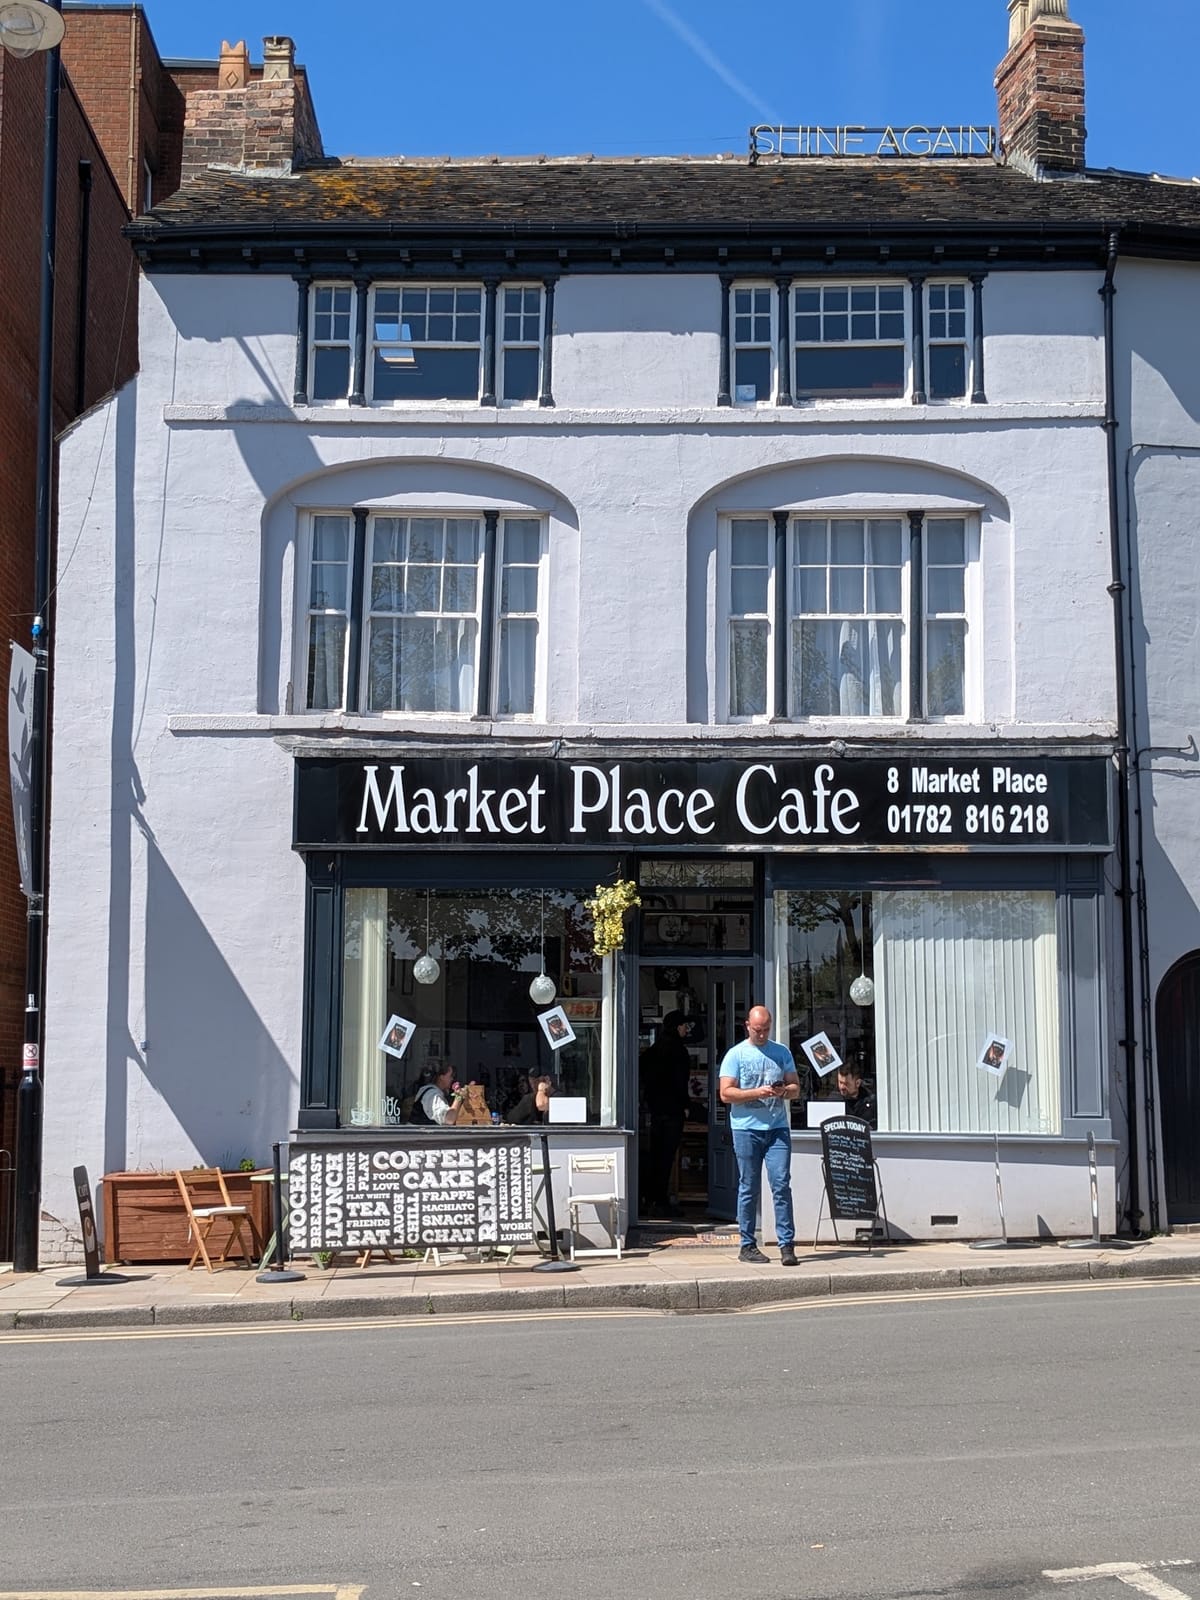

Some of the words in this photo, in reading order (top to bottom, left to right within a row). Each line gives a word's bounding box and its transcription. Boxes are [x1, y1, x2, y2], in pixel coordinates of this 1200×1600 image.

[754, 124, 865, 156] SHINE
[877, 124, 992, 156] AGAIN
[887, 767, 899, 793] 8
[912, 767, 980, 793] Market
[993, 767, 1048, 793] Place
[356, 765, 546, 834] Market
[570, 764, 715, 834] Place
[736, 764, 860, 834] Cafe
[887, 805, 952, 833] 01782
[824, 1121, 846, 1133] SPECIAL
[846, 1121, 866, 1133] TODAY
[346, 1152, 356, 1191] DRINK
[358, 1152, 370, 1191] PLAY
[373, 1149, 475, 1170] COFFEE
[403, 1170, 475, 1189] CAKE
[498, 1147, 508, 1220] AMERICANO
[510, 1147, 522, 1220] MORNING
[290, 1153, 307, 1248] MOCHA
[311, 1153, 322, 1248] BREAKFAST
[325, 1153, 343, 1238] LUNCH
[422, 1191, 475, 1201] FRAPPE
[422, 1203, 475, 1212] MACHIATO
[477, 1148, 497, 1242] RELAX
[346, 1202, 390, 1217] TEA
[346, 1219, 390, 1227] FRIENDS
[393, 1193, 404, 1245] LAUGH
[407, 1192, 419, 1244] CHILL
[422, 1214, 475, 1226] SNACK
[346, 1230, 390, 1246] EAT
[422, 1229, 475, 1243] CHAT
[500, 1222, 532, 1231] WORK
[501, 1233, 532, 1241] LUNCH
